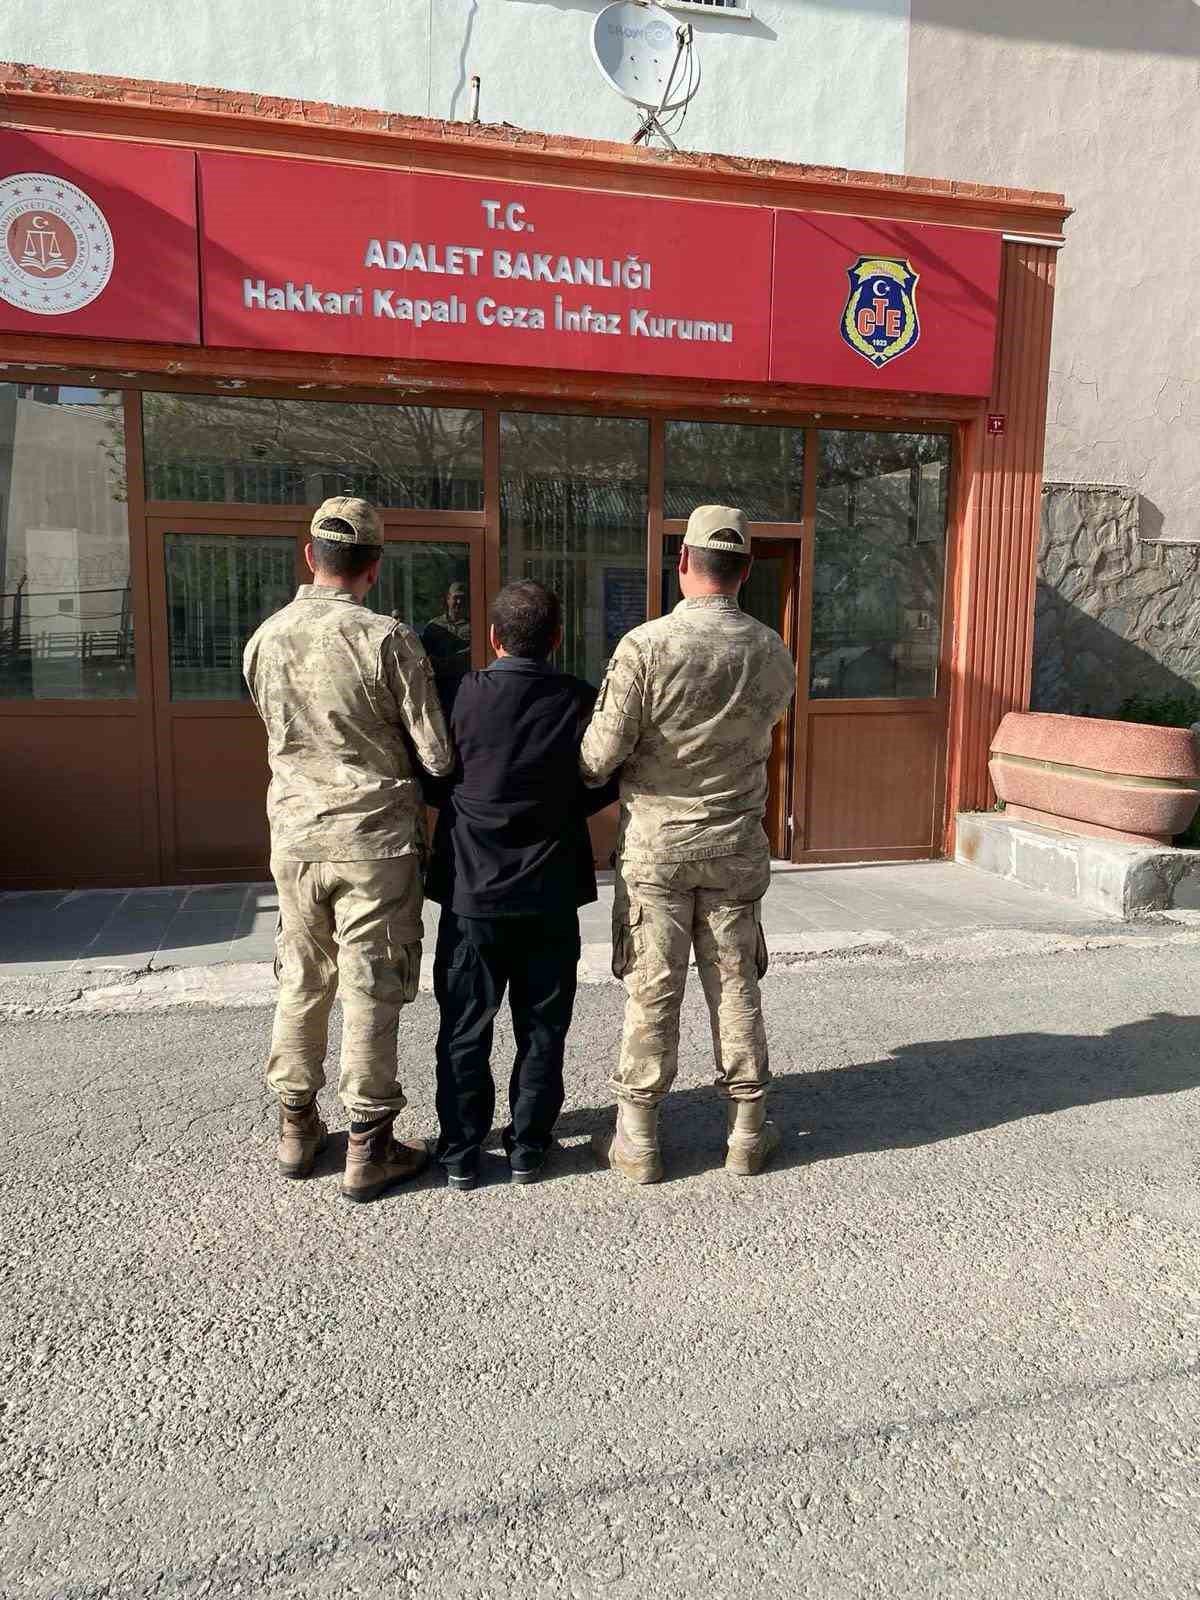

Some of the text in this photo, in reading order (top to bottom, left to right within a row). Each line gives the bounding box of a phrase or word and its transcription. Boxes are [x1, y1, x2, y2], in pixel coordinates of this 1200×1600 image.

[481, 200, 535, 233] T.C.
[364, 239, 652, 290] ADALET BAKANLIĞI
[243, 278, 733, 343] Hakkari Kapalı Ceza İnfaz Kurumu
